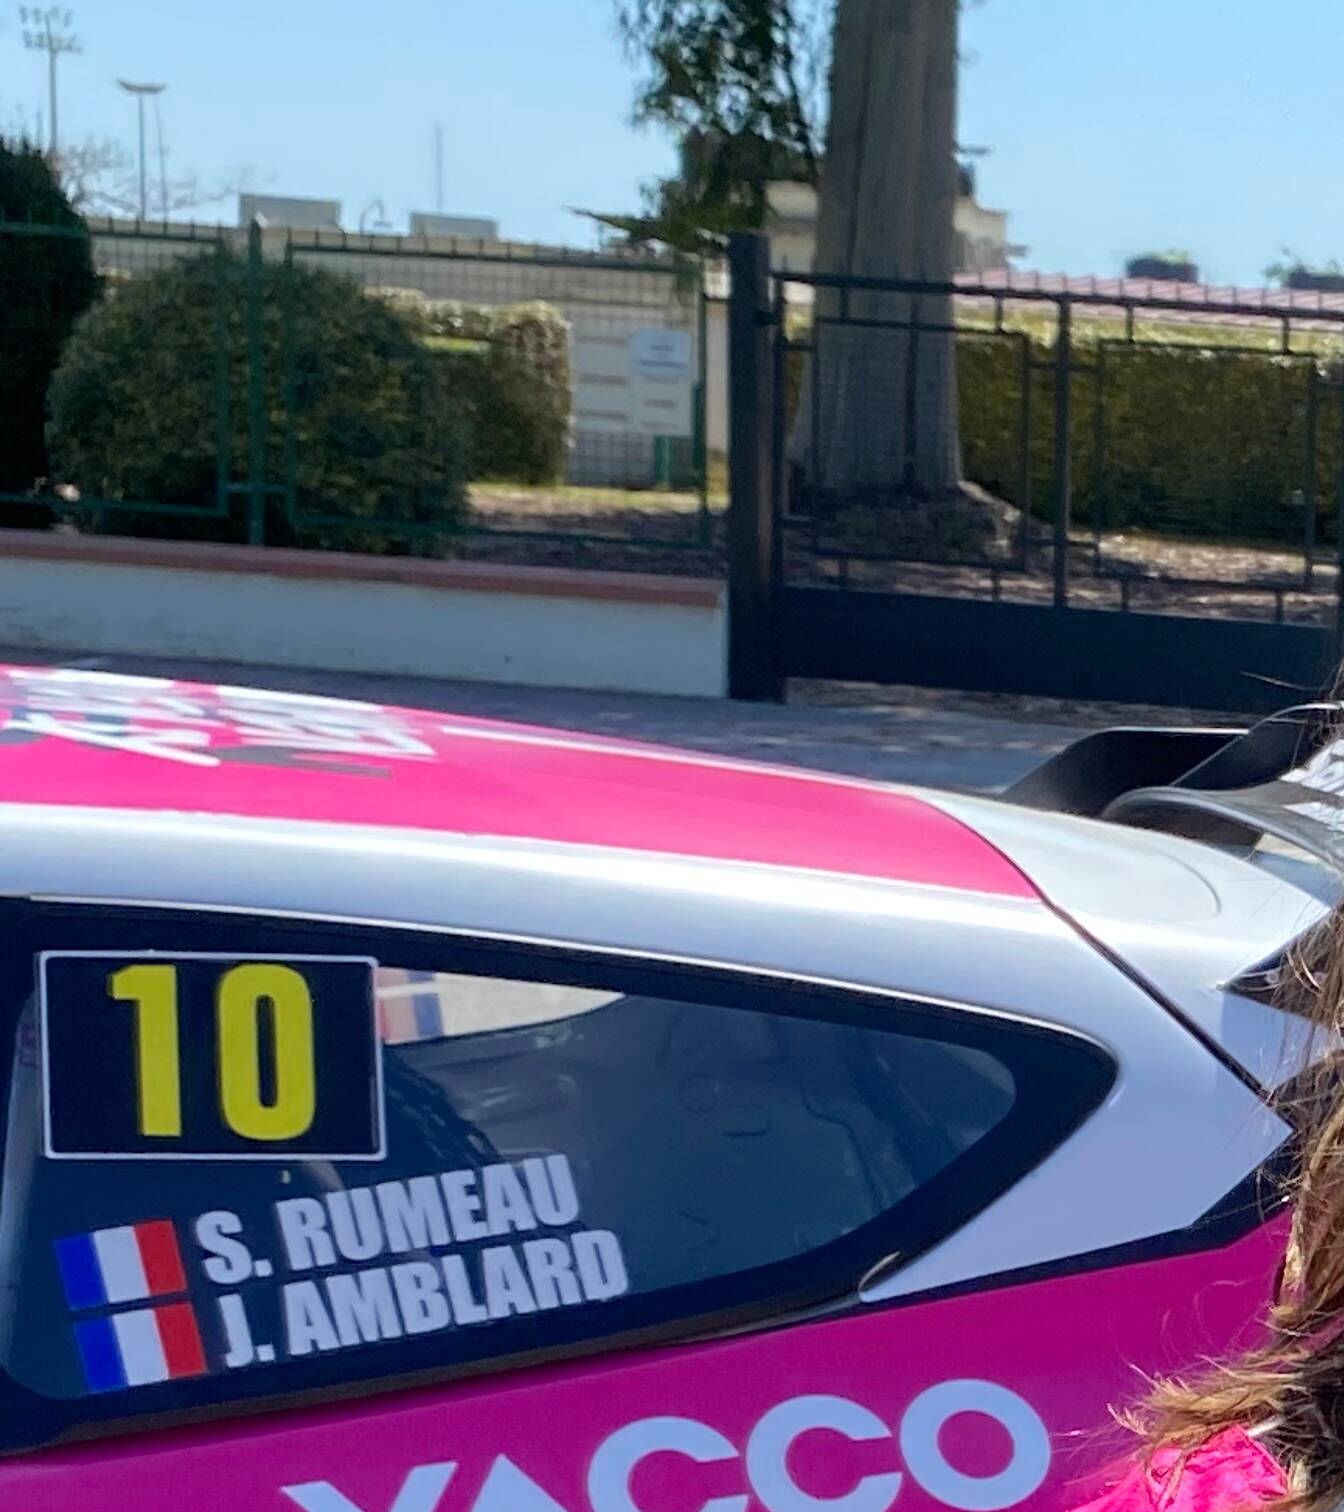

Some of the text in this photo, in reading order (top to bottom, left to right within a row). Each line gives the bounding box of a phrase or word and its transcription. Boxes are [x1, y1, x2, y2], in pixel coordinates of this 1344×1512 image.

[110, 963, 317, 1141] 10
[195, 1153, 580, 1285] S. RUMEAU
[218, 1229, 629, 1369] J. AMBLARD
